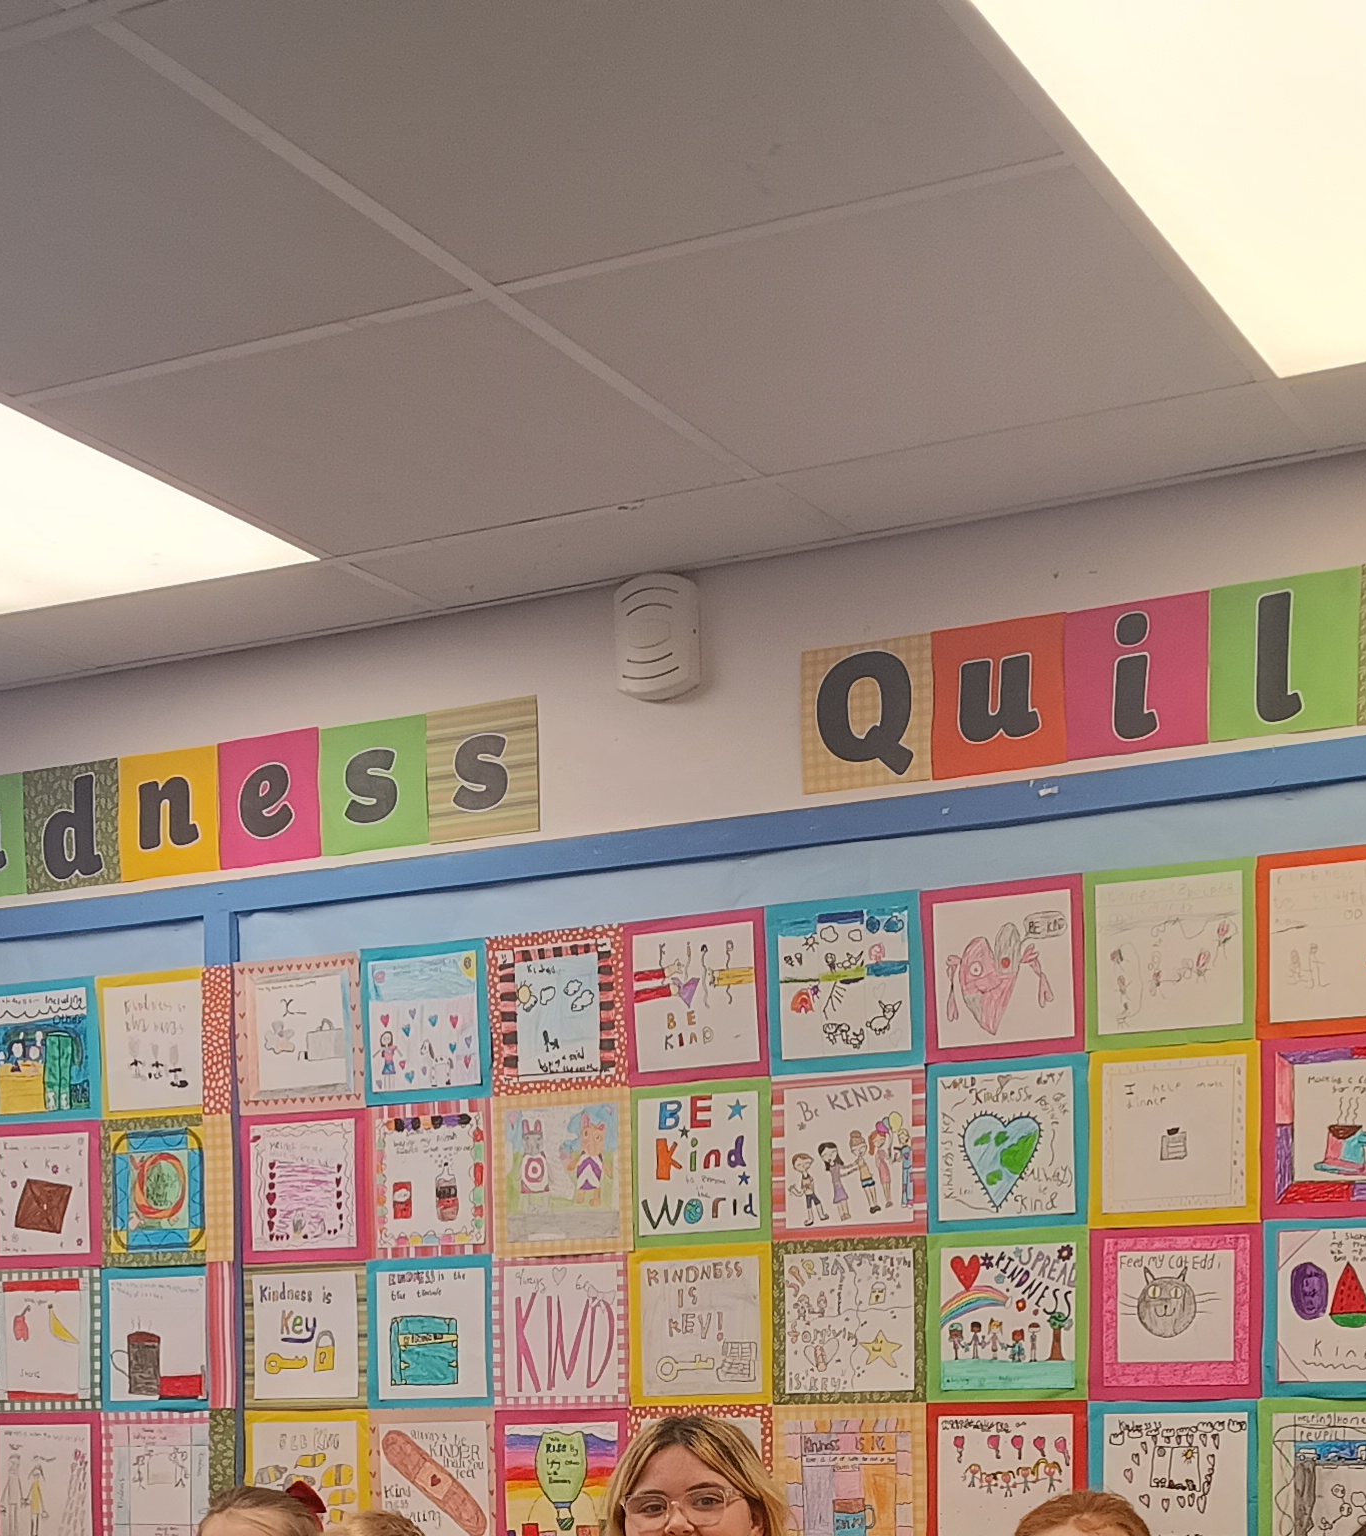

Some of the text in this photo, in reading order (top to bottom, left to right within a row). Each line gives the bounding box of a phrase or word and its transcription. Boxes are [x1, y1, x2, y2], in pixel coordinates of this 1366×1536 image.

[666, 1009, 697, 1030] BE
[825, 1084, 883, 1112] KIND
[657, 1094, 713, 1131] BE
[655, 1134, 747, 1181] Kind
[640, 1192, 759, 1230] World
[646, 1260, 744, 1288] KINDNESS
[1016, 1246, 1077, 1289] SPREAD
[1119, 1254, 1145, 1270] Feed
[1147, 1254, 1166, 1269] my
[259, 1281, 333, 1305] Kindness is
[677, 1286, 698, 1309] IS
[994, 1251, 1073, 1323] KINDNESS
[280, 1309, 317, 1344] Key
[514, 1290, 615, 1394] KIND
[429, 1444, 482, 1462] KINDER
[545, 1442, 569, 1454] RISE
